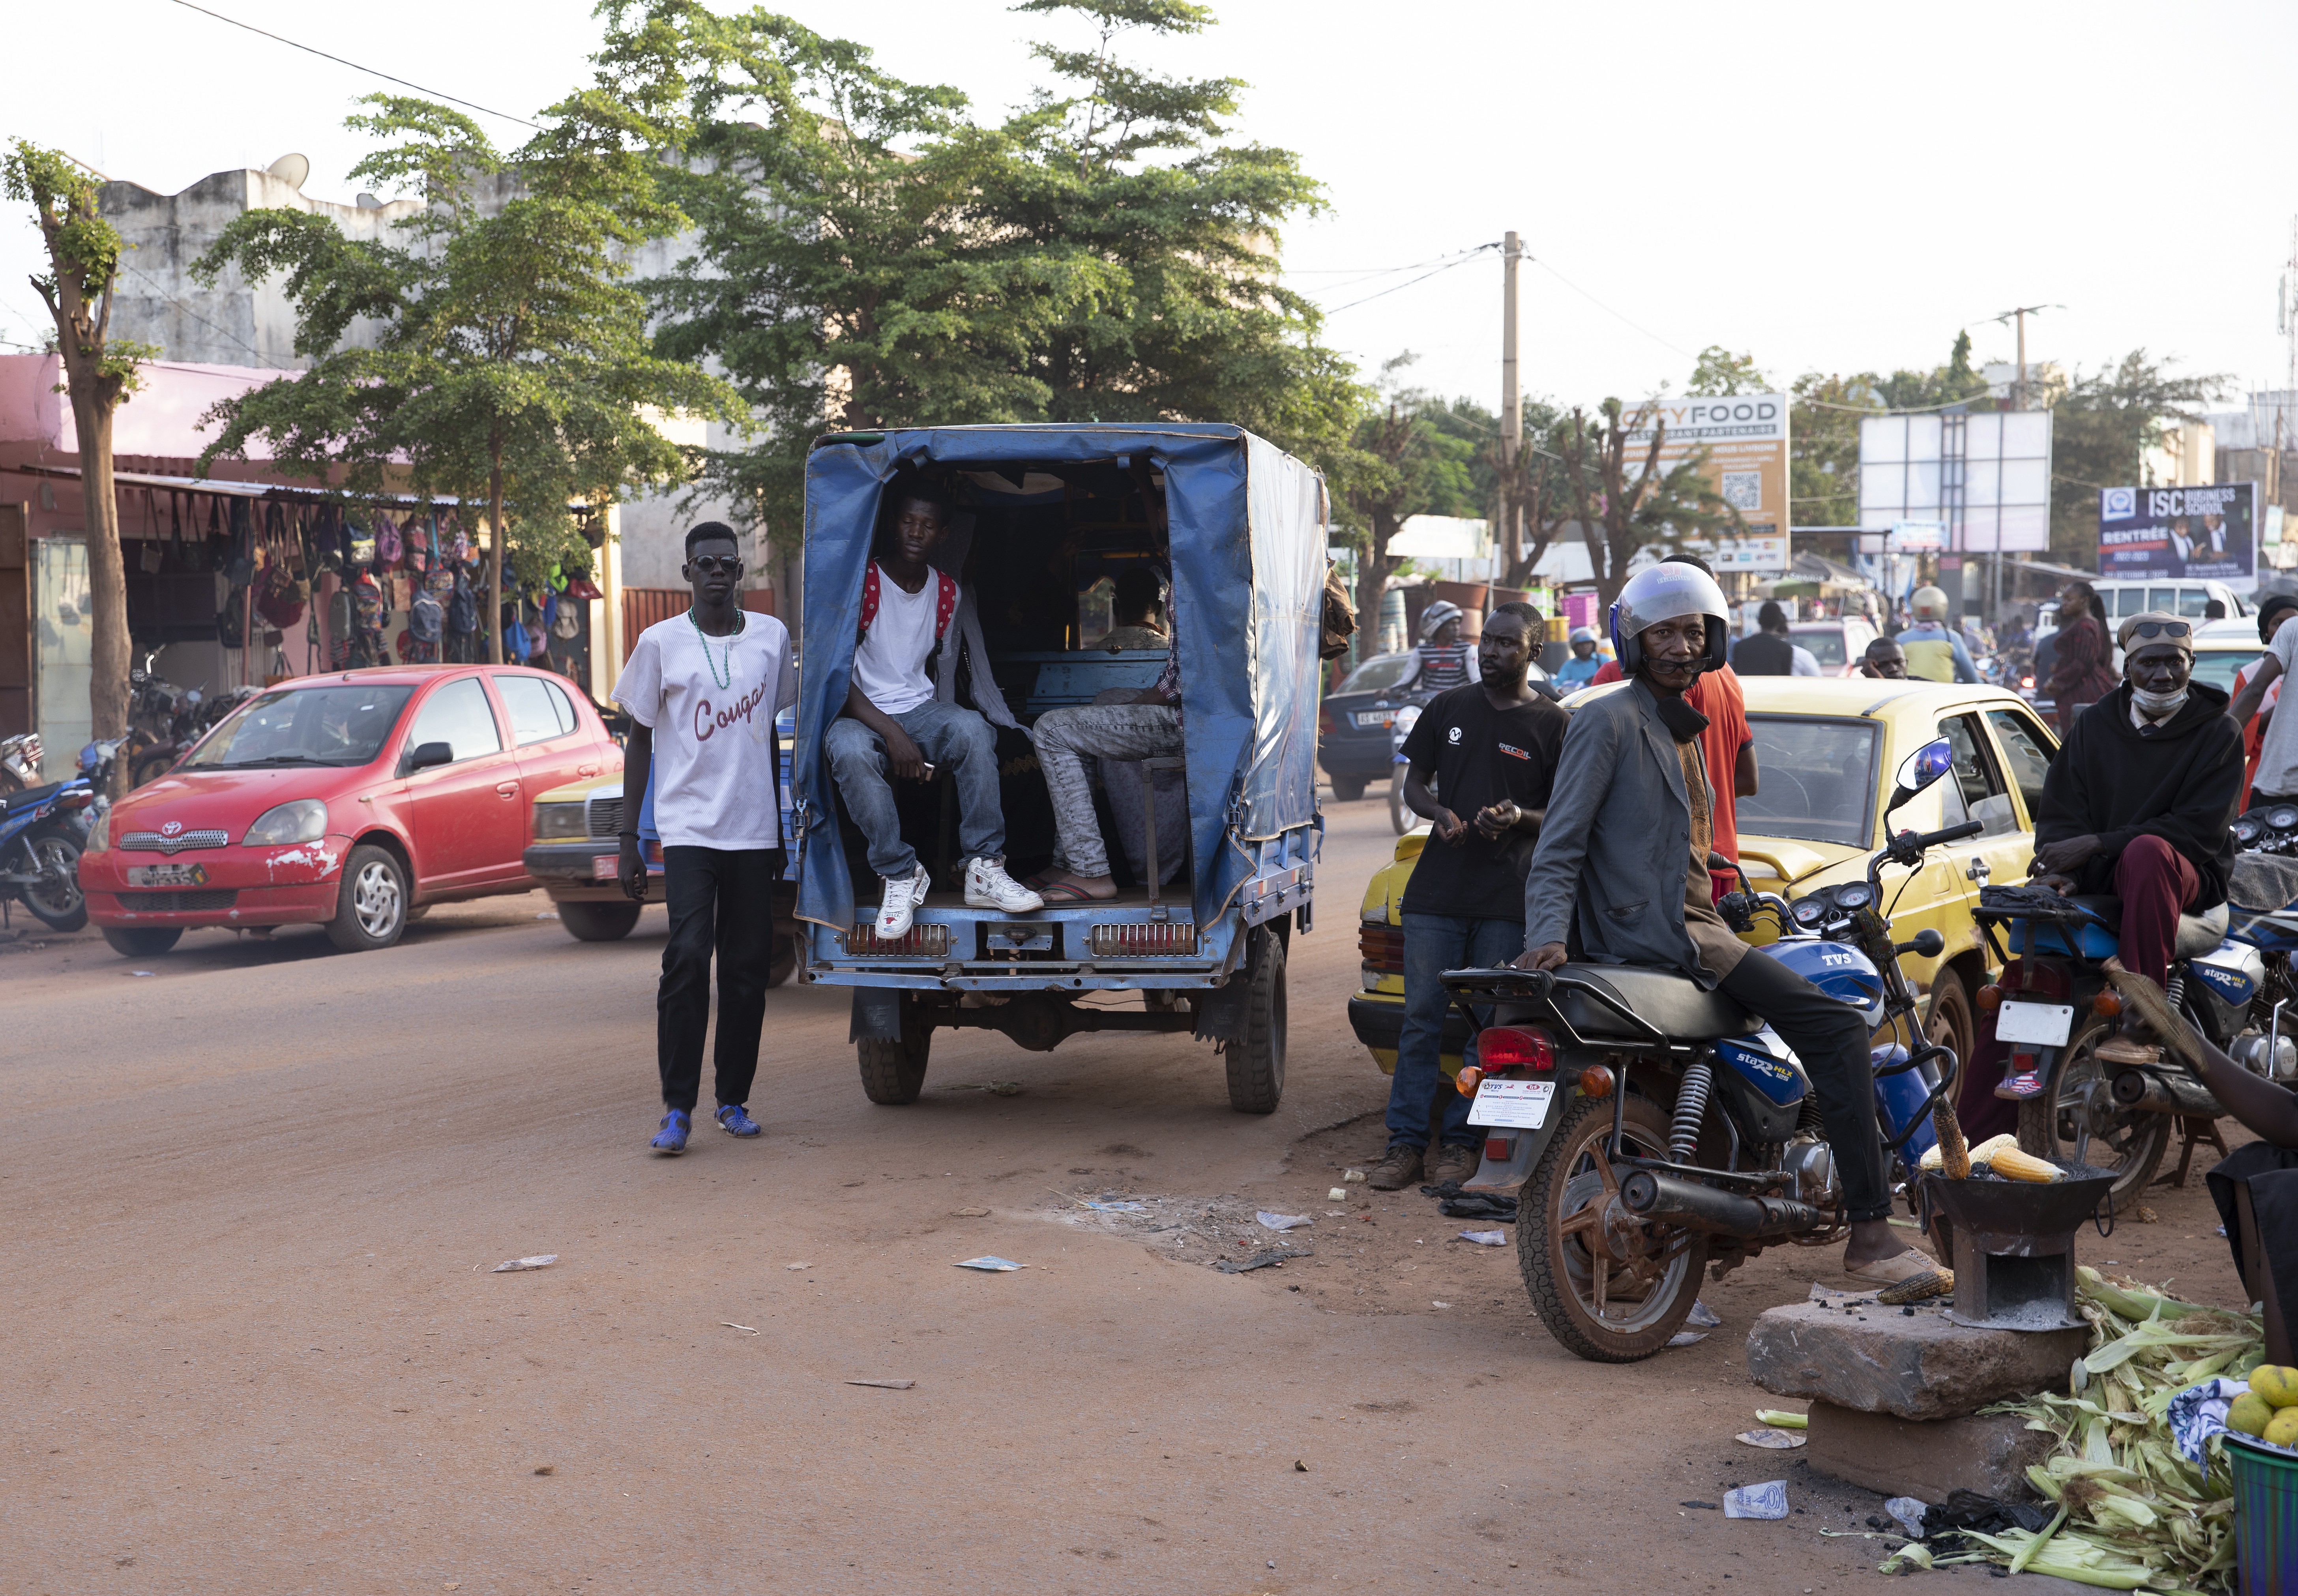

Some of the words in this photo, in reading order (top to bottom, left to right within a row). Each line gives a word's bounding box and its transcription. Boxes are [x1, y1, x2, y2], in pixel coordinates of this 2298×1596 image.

[2148, 489, 2184, 517] ISC
[2184, 487, 2235, 503] BUSINESS
[2184, 502, 2226, 516] SCHOOL
[2102, 525, 2169, 545] RENTRÉE
[1499, 742, 1531, 759] RECOIL
[1821, 953, 1852, 966] TVS
[1774, 1065, 1793, 1077] HLX
[1776, 1072, 1789, 1082] 125
[1558, 1157, 1570, 1182] DURA
[1569, 1134, 1581, 1154] GRIP
